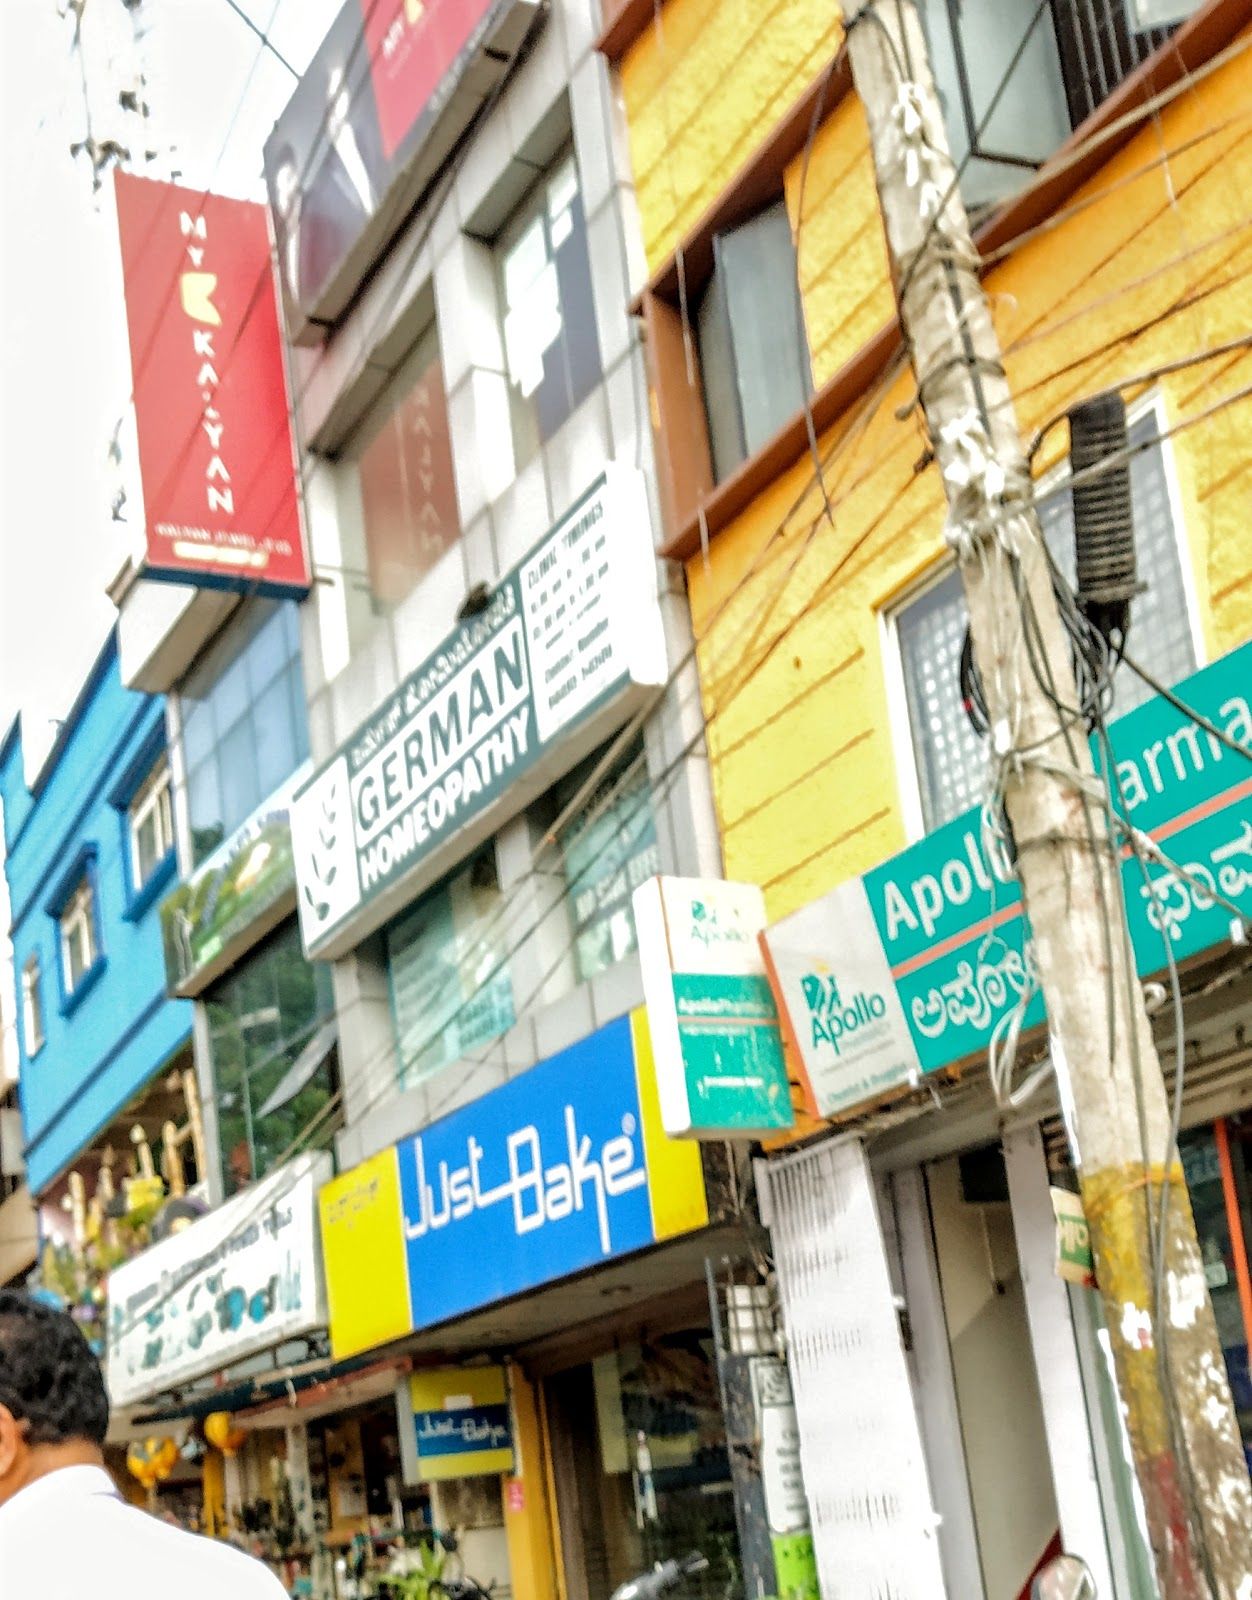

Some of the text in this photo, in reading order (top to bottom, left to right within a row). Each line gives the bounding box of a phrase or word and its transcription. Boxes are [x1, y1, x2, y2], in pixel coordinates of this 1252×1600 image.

[179, 210, 207, 268] MY
[357, 630, 524, 832] GERMAN
[360, 706, 529, 891] HOMEOPATHY
[811, 990, 886, 1057] Apollo
[404, 1135, 513, 1240] Just
